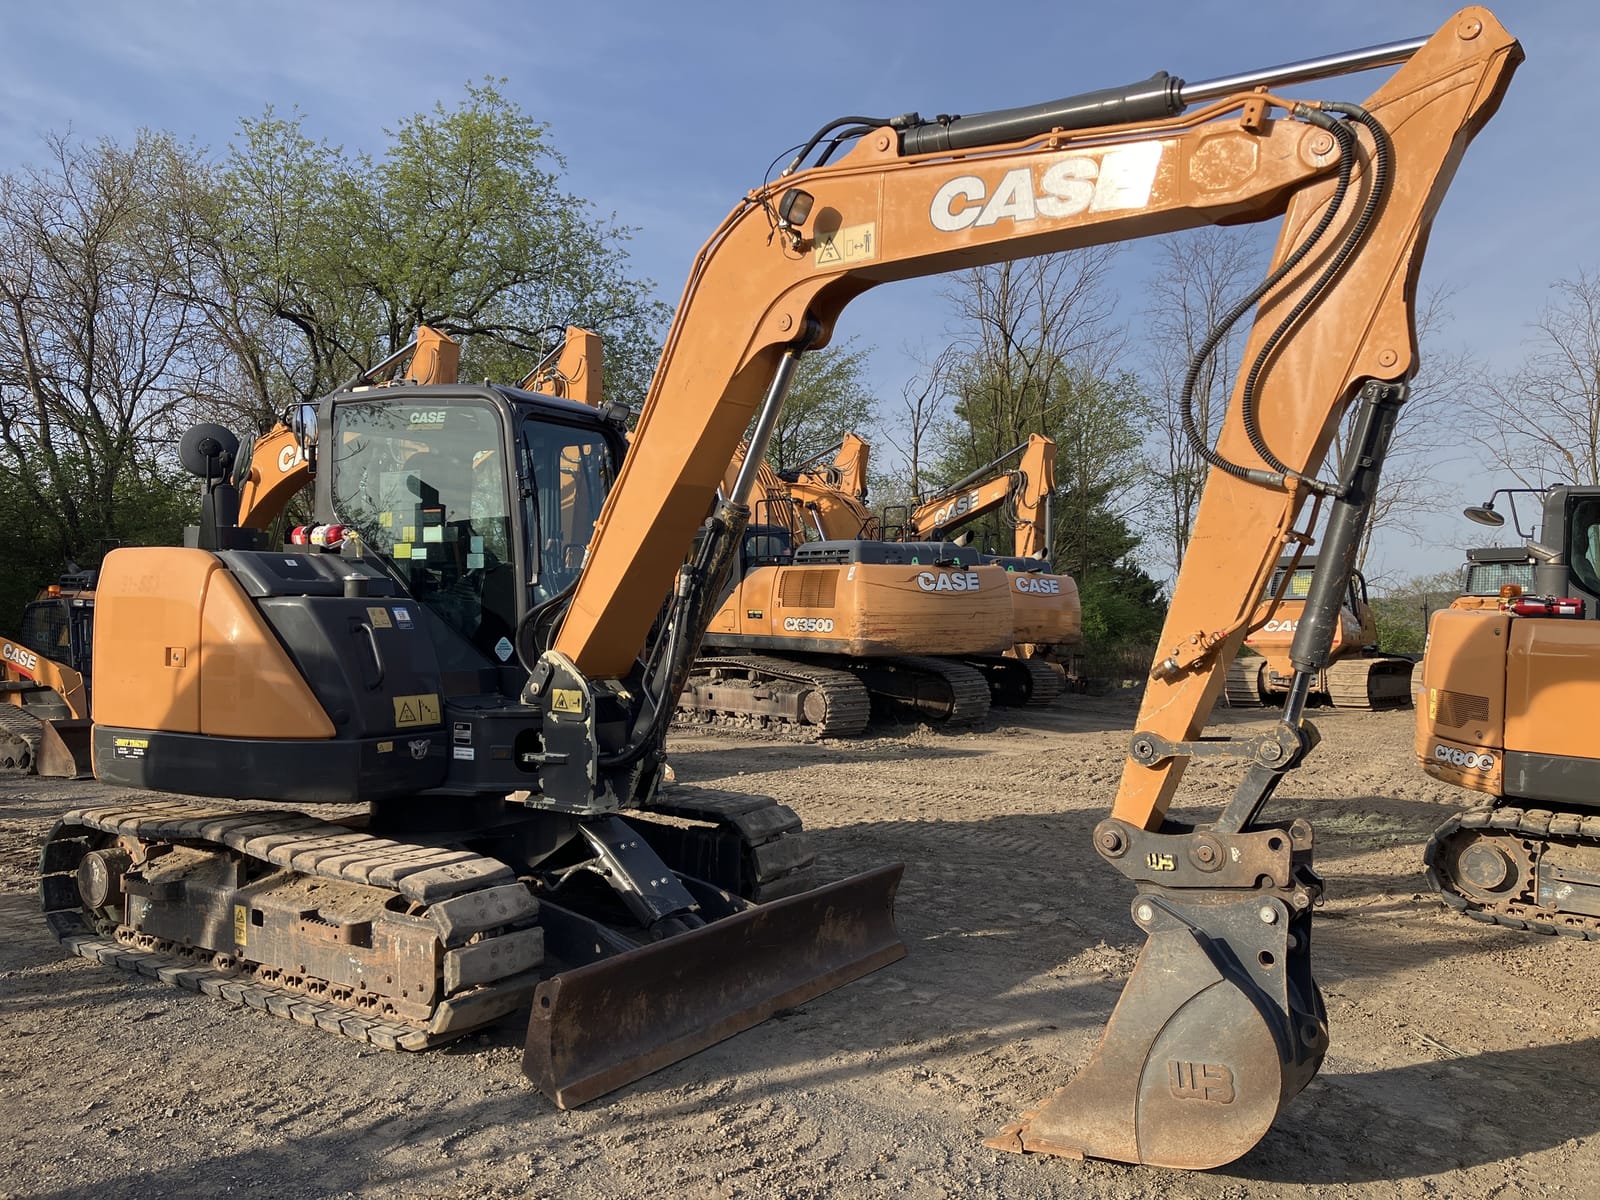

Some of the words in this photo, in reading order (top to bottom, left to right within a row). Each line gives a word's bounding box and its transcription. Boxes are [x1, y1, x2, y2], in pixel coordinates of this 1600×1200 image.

[930, 140, 1163, 232] CASE
[410, 411, 446, 424] CASE
[933, 490, 979, 526] CASE
[917, 572, 980, 591] CASE
[1015, 577, 1060, 594] CASE
[784, 617, 834, 633] CX350D
[3, 643, 37, 671] CASE
[1435, 744, 1494, 772] CX80C
